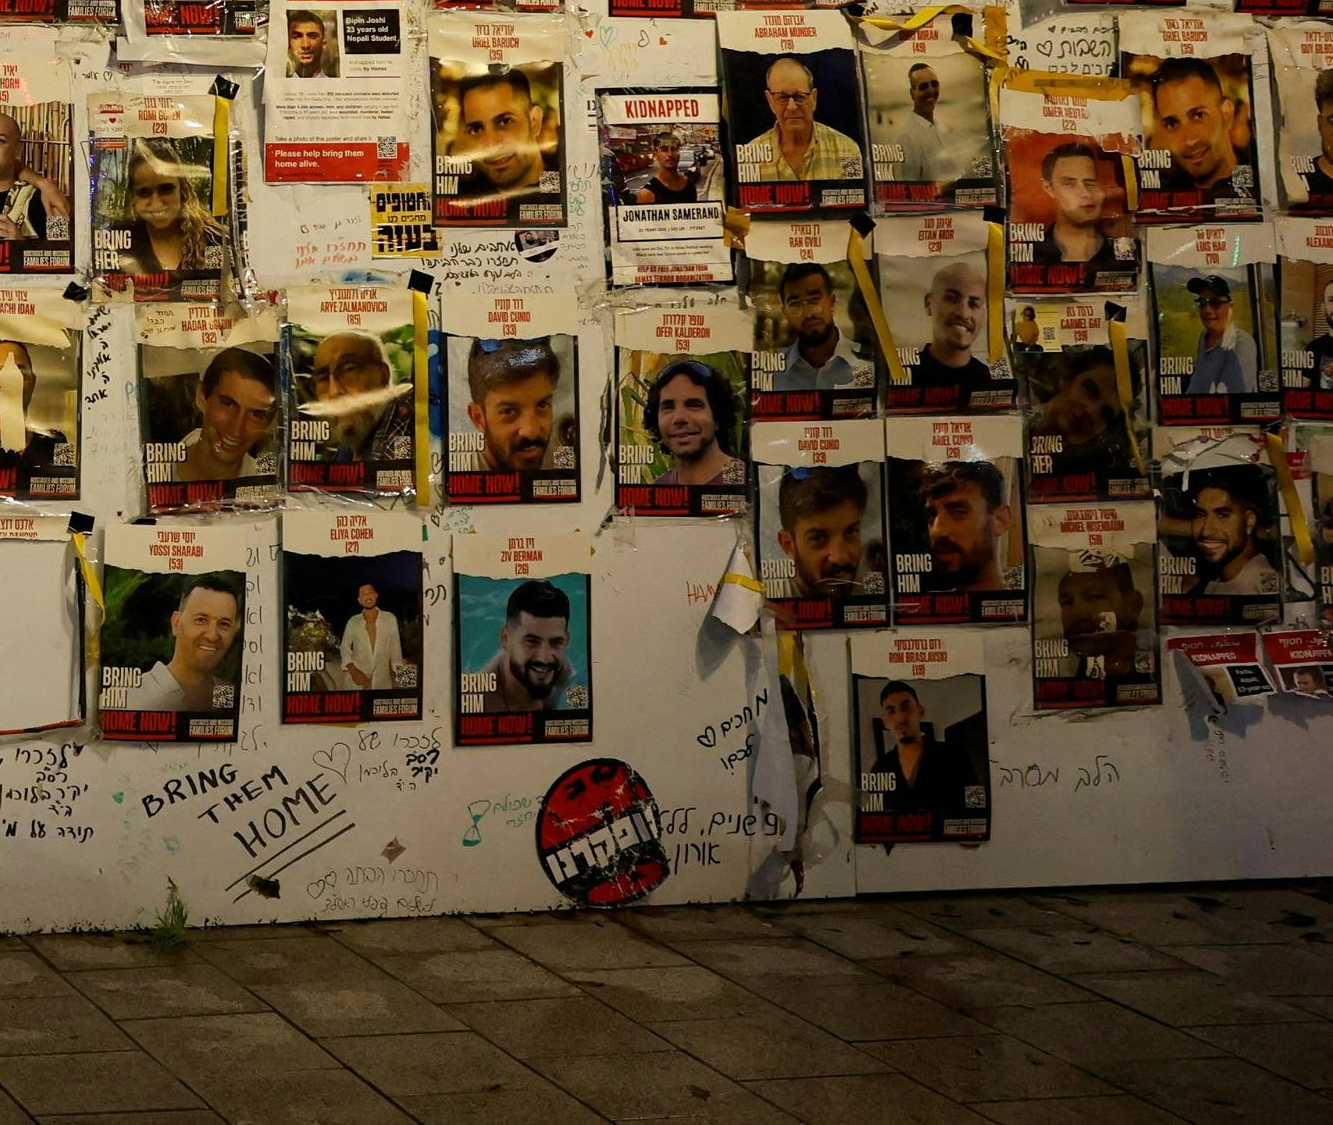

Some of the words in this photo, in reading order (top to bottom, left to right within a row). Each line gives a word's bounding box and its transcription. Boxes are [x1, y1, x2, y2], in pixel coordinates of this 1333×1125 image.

[346, 17, 365, 26] Bipin
[367, 17, 386, 25] Joshi
[346, 26, 356, 34] 23
[357, 27, 376, 36] years
[347, 35, 369, 44] Nepali
[371, 35, 397, 43] Student
[625, 99, 699, 118] KIDNAPPED
[275, 150, 301, 158] Please
[303, 150, 320, 159] help
[322, 150, 343, 159] bring
[275, 160, 297, 168] home
[299, 160, 320, 168] alive.
[623, 210, 670, 222] JONATHAN
[673, 207, 719, 219] SAMERANO
[656, 327, 673, 337] OFER
[675, 327, 710, 338] KALDERON
[676, 339, 690, 351] (53)
[149, 545, 170, 555] YOSSI
[172, 545, 203, 557] SHARABI
[169, 558, 183, 570] (53)
[1075, 756, 1120, 792] הלב
[142, 763, 238, 818] BRING
[198, 765, 289, 823] THEM
[234, 773, 337, 857] HOME
[57, 826, 93, 843] תודה
